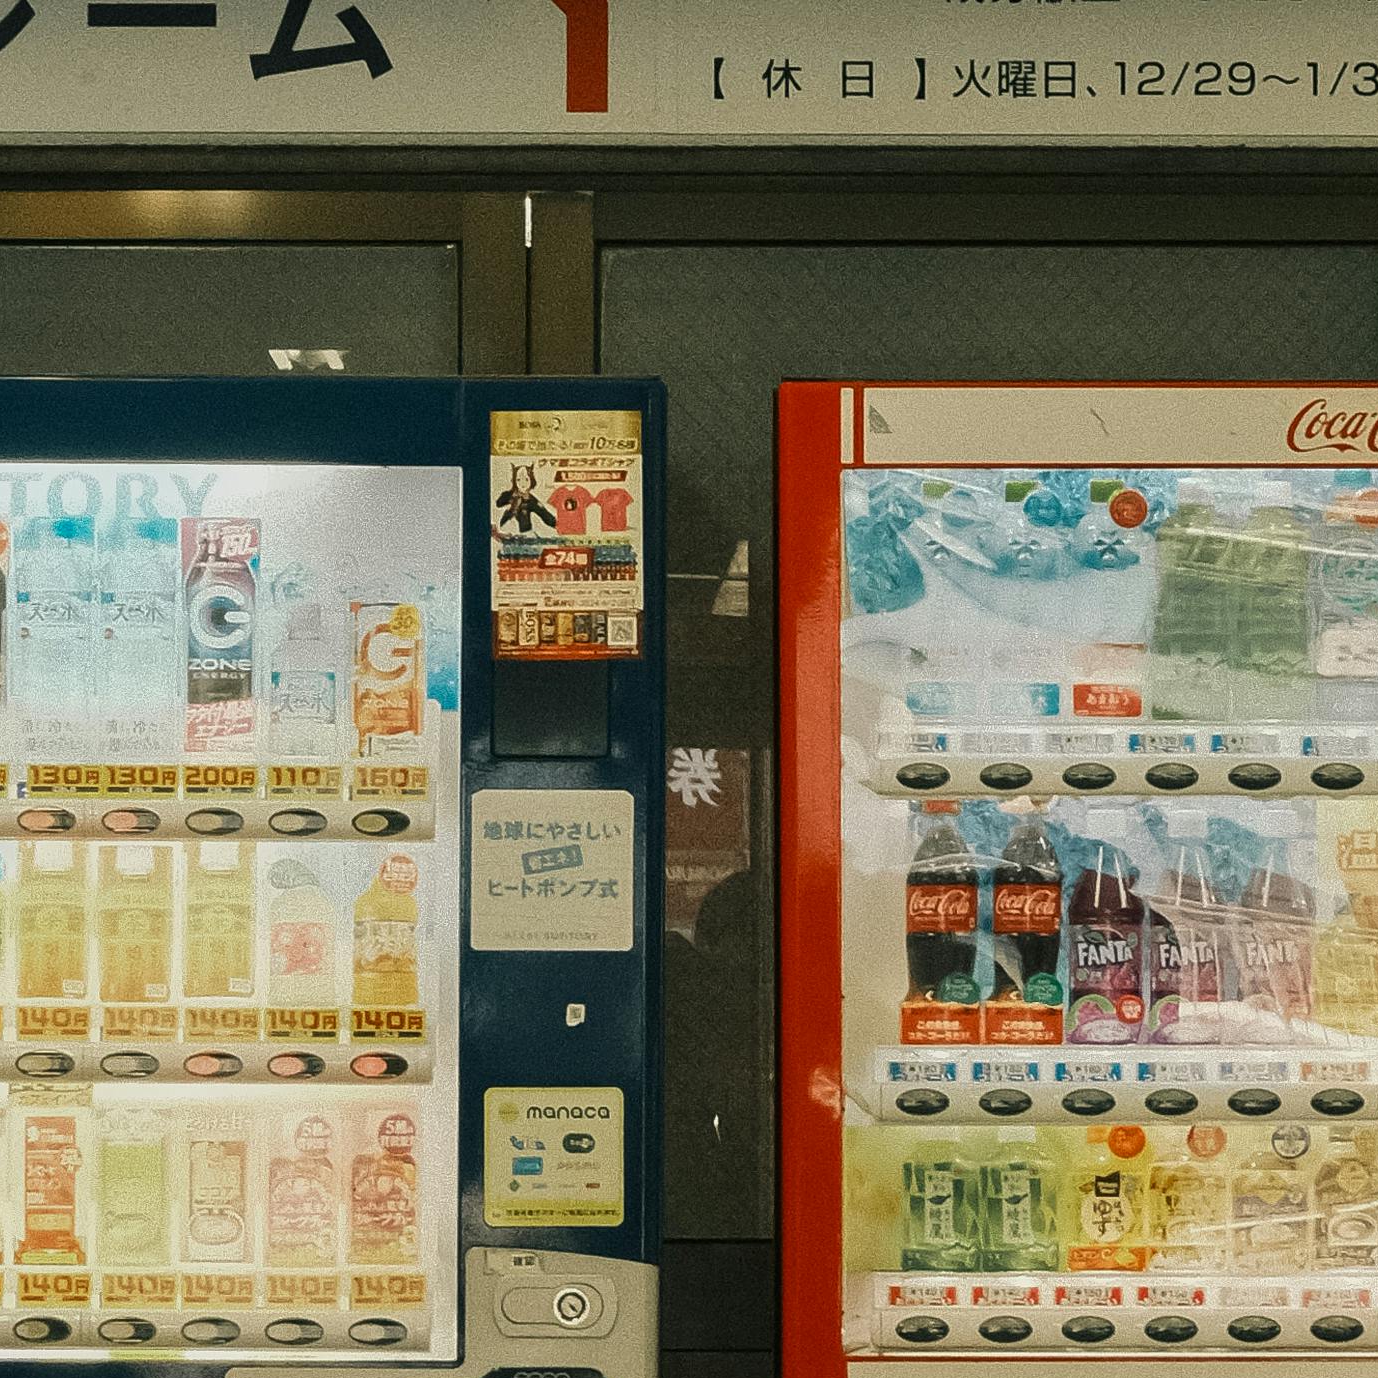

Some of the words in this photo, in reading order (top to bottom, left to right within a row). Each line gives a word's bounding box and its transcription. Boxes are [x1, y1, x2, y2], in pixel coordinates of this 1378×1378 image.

[31, 766, 100, 786] 130円
[109, 766, 177, 786] 130円
[186, 767, 255, 786] 200円
[484, 821, 621, 841] 地球にやさしい
[489, 878, 619, 899] ヒートポンプ式
[909, 888, 970, 917] Coca-Cola
[996, 888, 1057, 917] Coca-Cola
[1076, 938, 1133, 967] FANTA
[1160, 940, 1214, 968] FANTA
[353, 1009, 423, 1030] 140円
[527, 1106, 610, 1119] manaca
[23, 1274, 89, 1295] 140円
